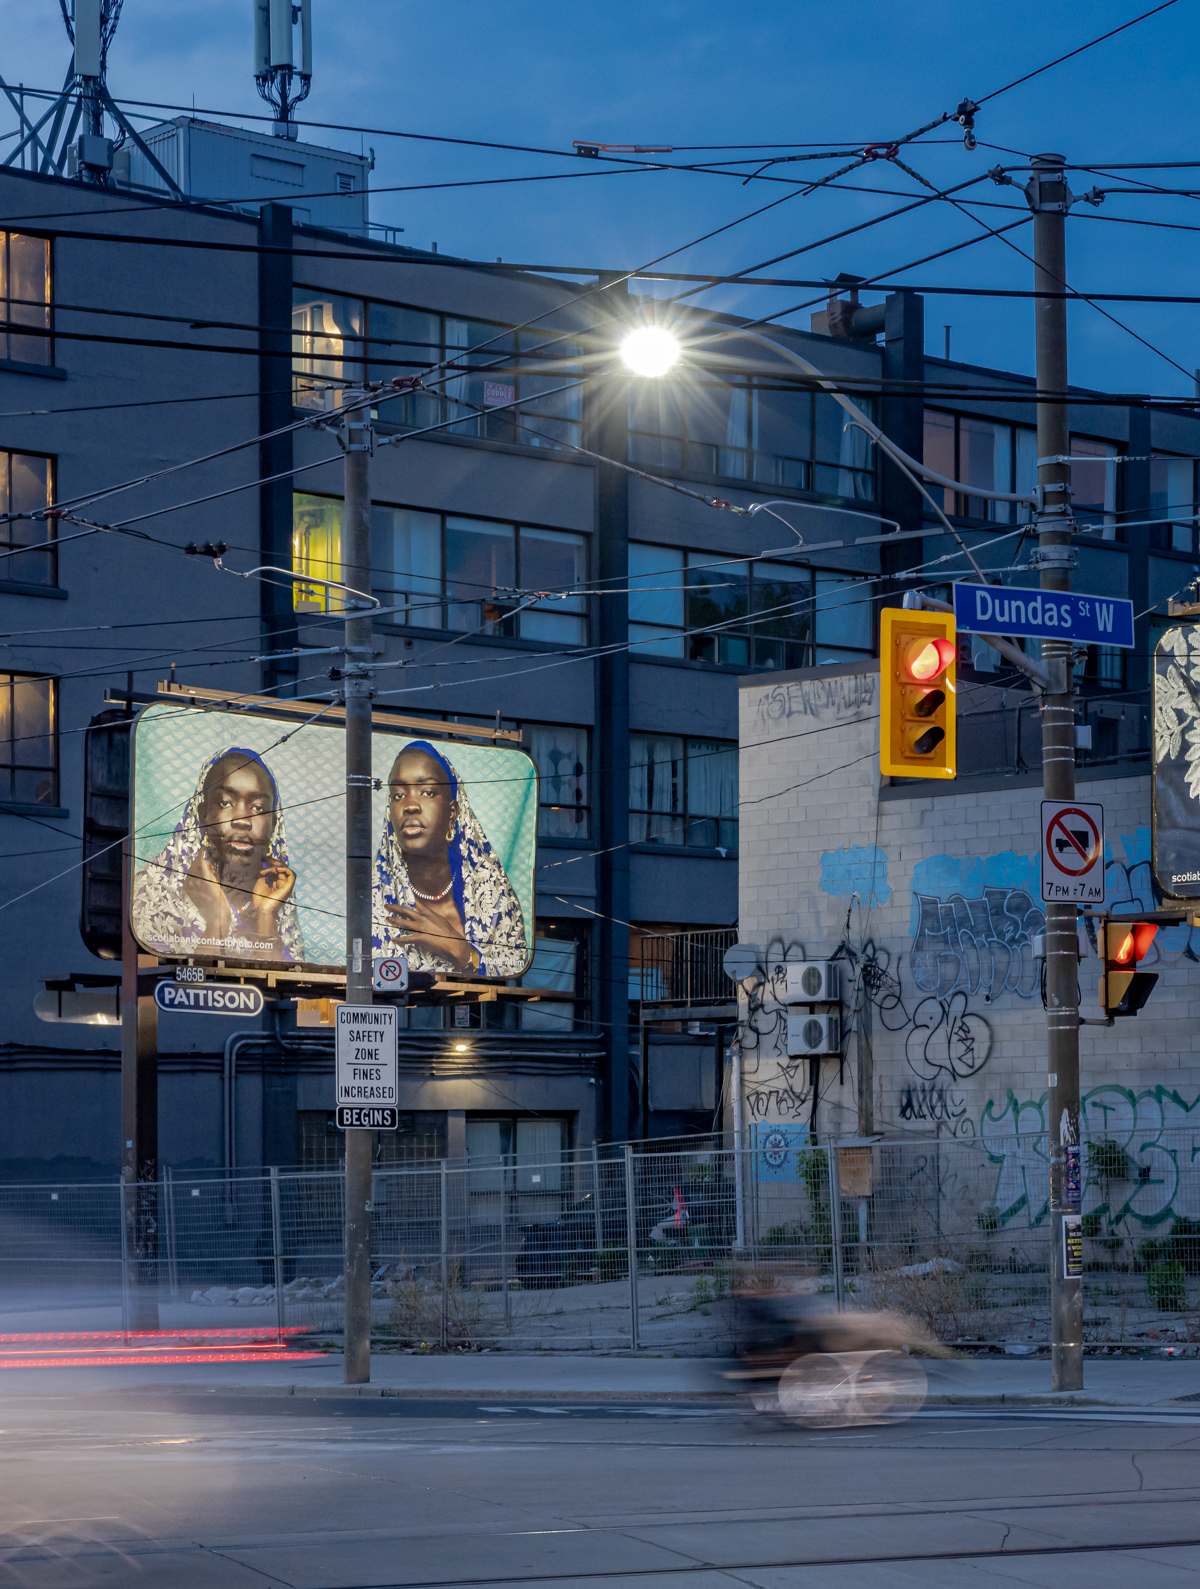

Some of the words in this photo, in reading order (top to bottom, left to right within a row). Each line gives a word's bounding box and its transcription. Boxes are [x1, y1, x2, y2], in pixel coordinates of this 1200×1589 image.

[975, 590, 1072, 628] Dundas
[1078, 601, 1091, 617] St
[1095, 601, 1114, 633] W
[1046, 882, 1054, 896] 7
[1055, 885, 1070, 897] PM
[1079, 883, 1086, 897] 7
[1088, 886, 1101, 897] AM
[147, 934, 274, 950] scotiabankcontactphoto.com
[175, 967, 205, 982] 5465B
[163, 987, 255, 1010] PATTISON
[340, 1011, 394, 1026] COMMUNITY
[349, 1030, 385, 1043] SAFETY
[354, 1048, 380, 1061] ZONE
[353, 1068, 382, 1081] FINES
[340, 1085, 395, 1100] INCREASED
[343, 1108, 392, 1126] BEGINS
